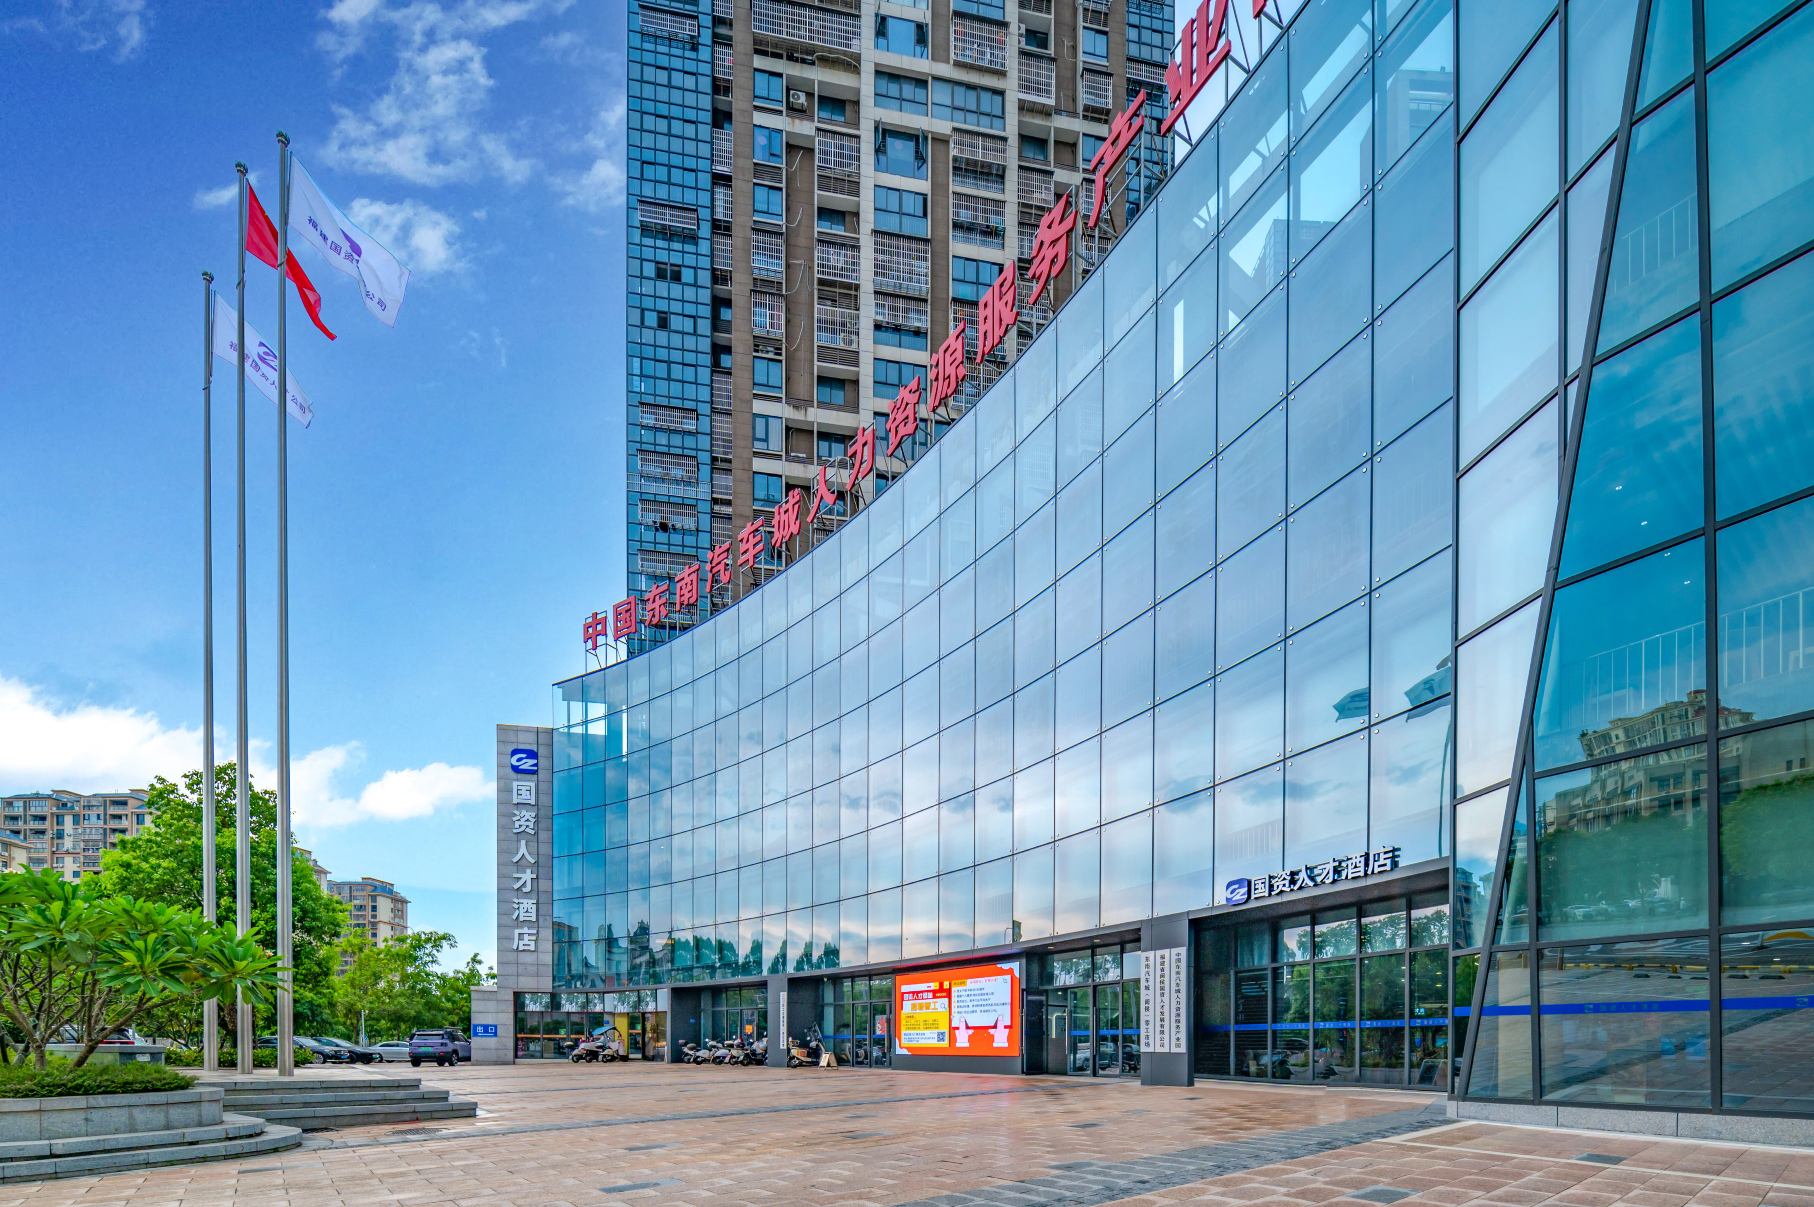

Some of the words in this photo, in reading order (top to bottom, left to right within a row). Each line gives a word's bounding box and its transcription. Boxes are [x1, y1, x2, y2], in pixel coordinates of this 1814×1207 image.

[583, 0, 1269, 651] 中国东南汽车城人力资源服务产业
[511, 781, 537, 951] 国资人才酒店
[1251, 845, 1400, 900] 国资人才酒店
[476, 1025, 495, 1033] 出口
